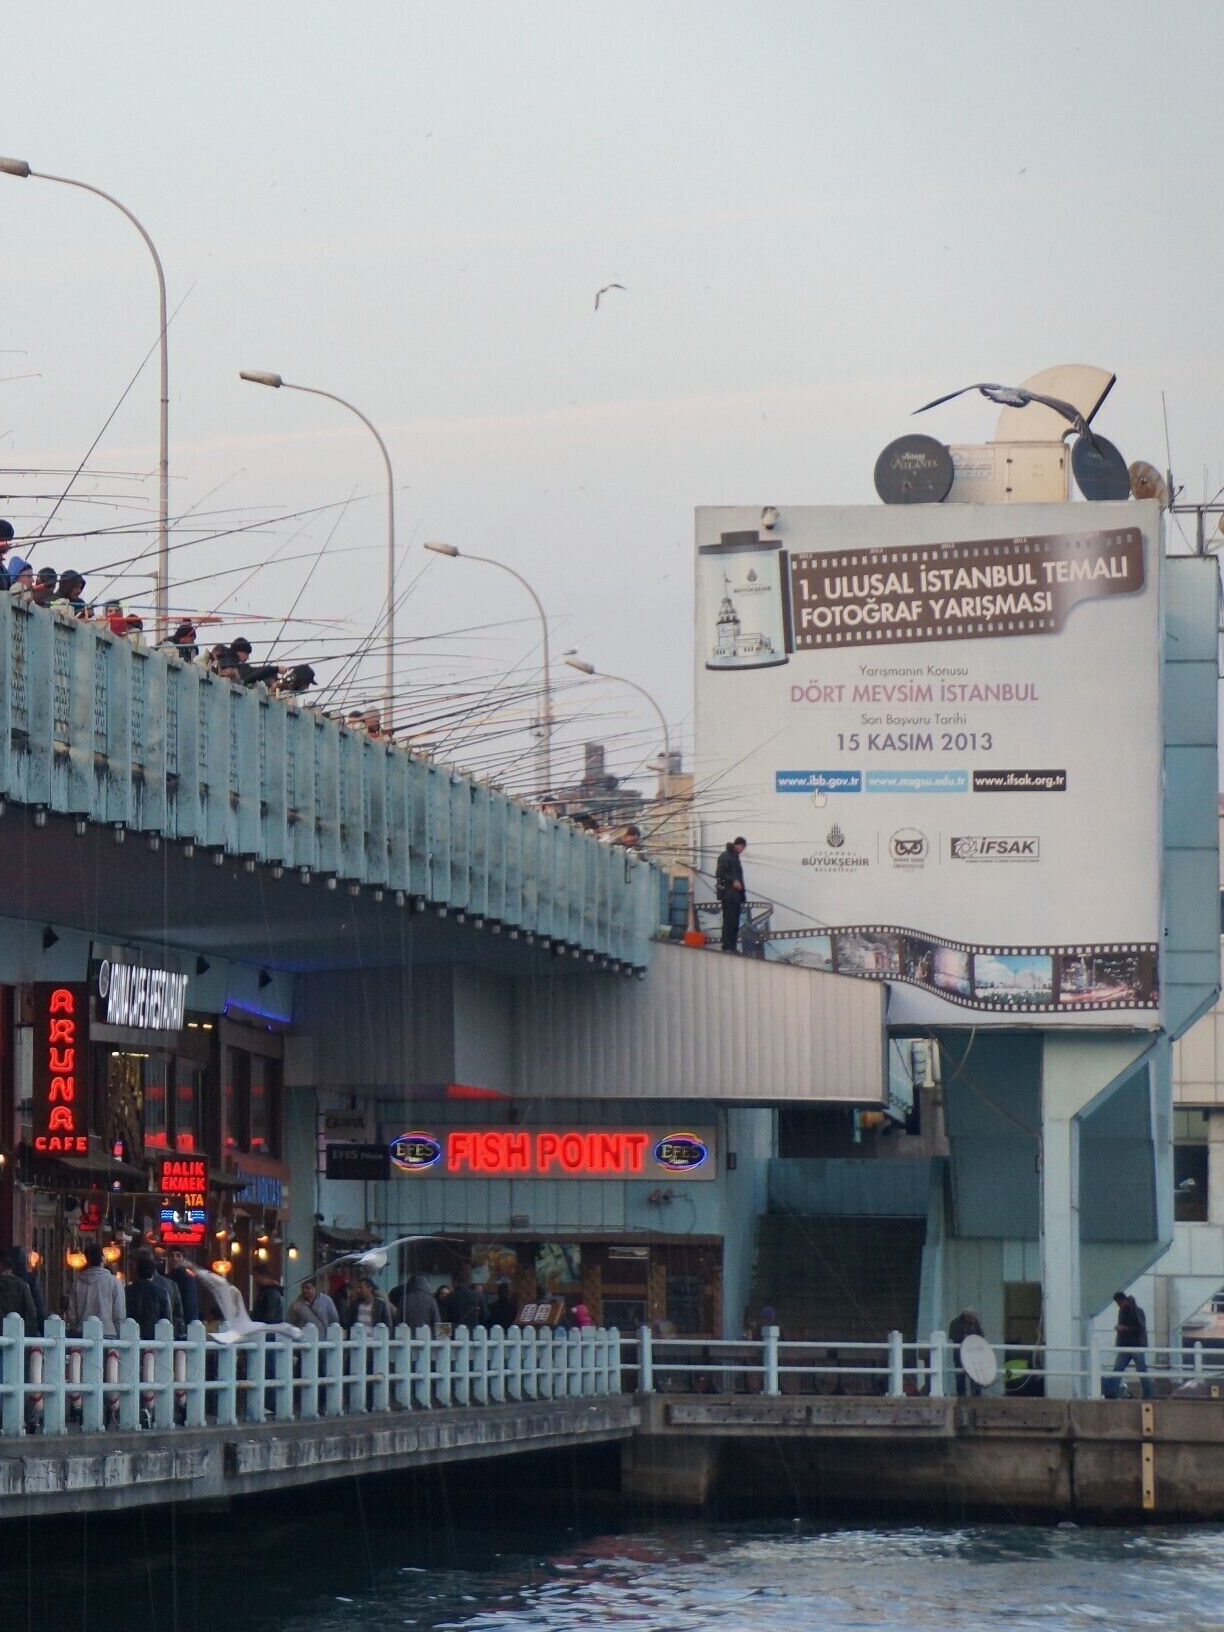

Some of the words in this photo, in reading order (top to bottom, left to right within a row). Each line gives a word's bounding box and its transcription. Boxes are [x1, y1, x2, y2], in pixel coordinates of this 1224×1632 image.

[800, 579, 817, 600] 1.
[825, 571, 914, 599] ULUSAL
[920, 563, 1037, 593] İSTANBUL
[1042, 556, 1128, 584] TEMALI
[801, 597, 923, 629] FOTOĞRAF
[928, 591, 1052, 620] YARIŞMASI
[927, 665, 968, 676] Konusu
[791, 680, 845, 702] DÖRT
[852, 679, 933, 702] MEVSİM
[941, 679, 1039, 702] İSTANBUL
[861, 713, 882, 724] Son
[886, 714, 931, 726] Başvuru
[935, 712, 967, 725] Tarihi
[838, 733, 860, 751] 15
[868, 733, 934, 751] KASIM
[941, 732, 993, 751] 2013
[778, 774, 860, 788] www.ibb.gov.tr
[975, 773, 1065, 788] www.ifsak.org.tr
[979, 837, 1036, 854] İFSAK
[48, 988, 75, 1132] ARUNA
[35, 1136, 87, 1151] CAFE
[396, 1142, 436, 1157] EFES
[448, 1132, 530, 1172] FISH
[537, 1132, 648, 1173] POINT
[661, 1144, 701, 1159] EFES
[163, 1161, 205, 1176] BALIK
[160, 1176, 206, 1191] EKMEK
